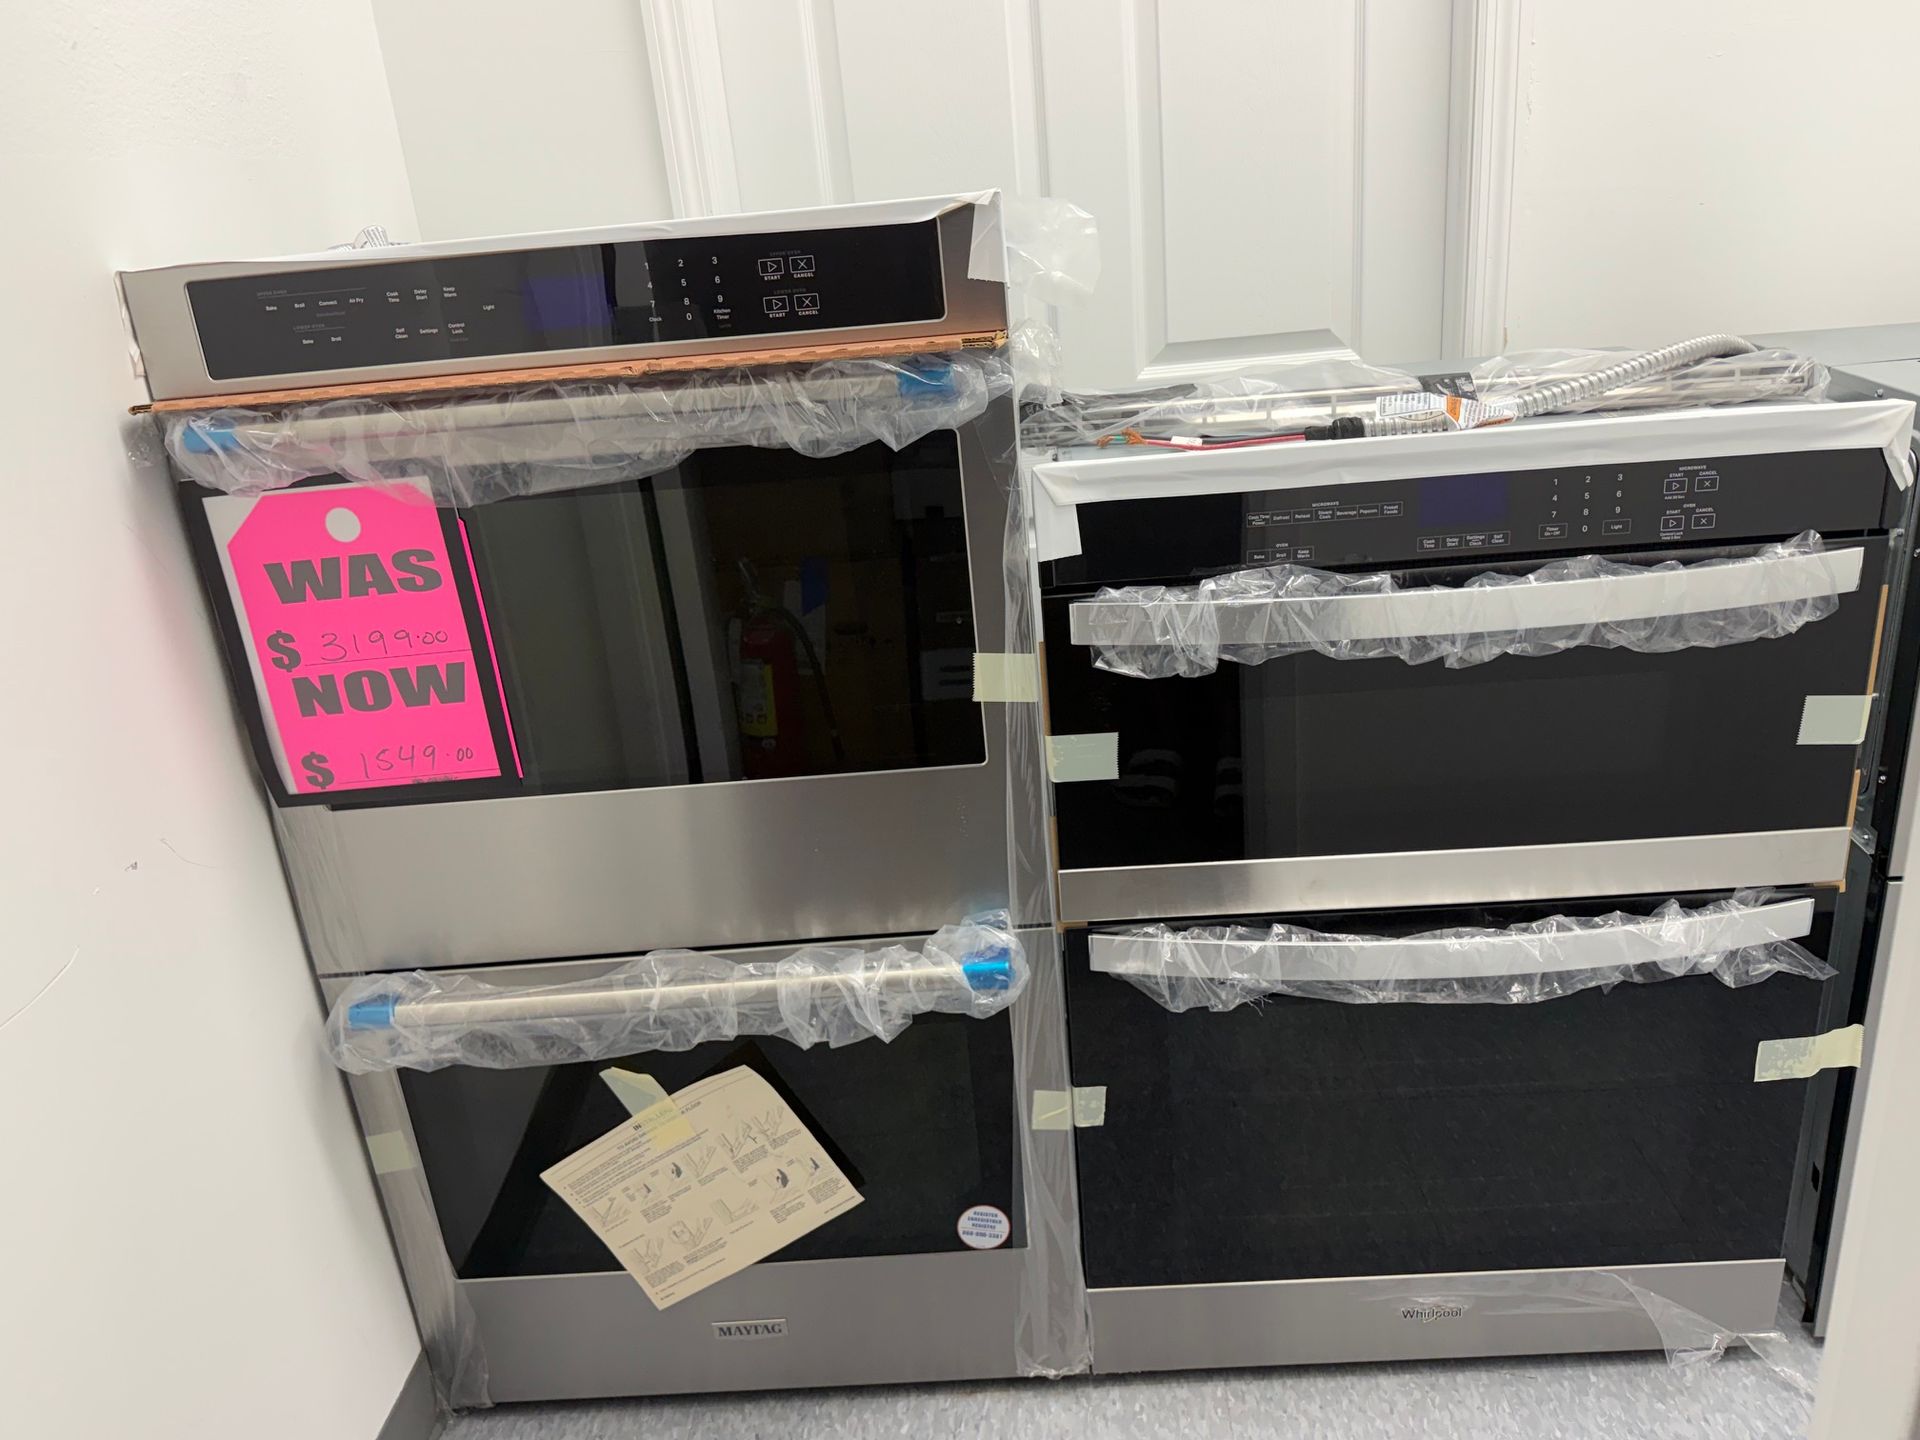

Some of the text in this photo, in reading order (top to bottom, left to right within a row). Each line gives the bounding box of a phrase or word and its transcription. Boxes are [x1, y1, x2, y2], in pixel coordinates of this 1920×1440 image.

[678, 259, 684, 267] 2
[712, 256, 718, 265] 3
[644, 262, 650, 270] 1
[681, 278, 687, 287] 5
[714, 275, 720, 284] 6
[684, 297, 690, 305] 8
[717, 294, 723, 302] 9
[686, 312, 692, 321] 0
[1585, 475, 1591, 483] 2
[1617, 473, 1623, 481] 3
[1553, 478, 1558, 486] 1
[1552, 494, 1558, 502] 4
[1584, 491, 1590, 499] 5
[1551, 510, 1557, 518] 7
[1583, 507, 1589, 516] 8
[1615, 506, 1621, 514] 9
[1582, 525, 1588, 533] 0
[263, 549, 443, 605] WAS
[266, 630, 449, 673] $ 3199.00
[291, 662, 466, 718] NOW
[301, 744, 474, 790] $ 1549.00
[1402, 1307, 1462, 1320] Whirlpool
[718, 1323, 782, 1337] MAYTAG
